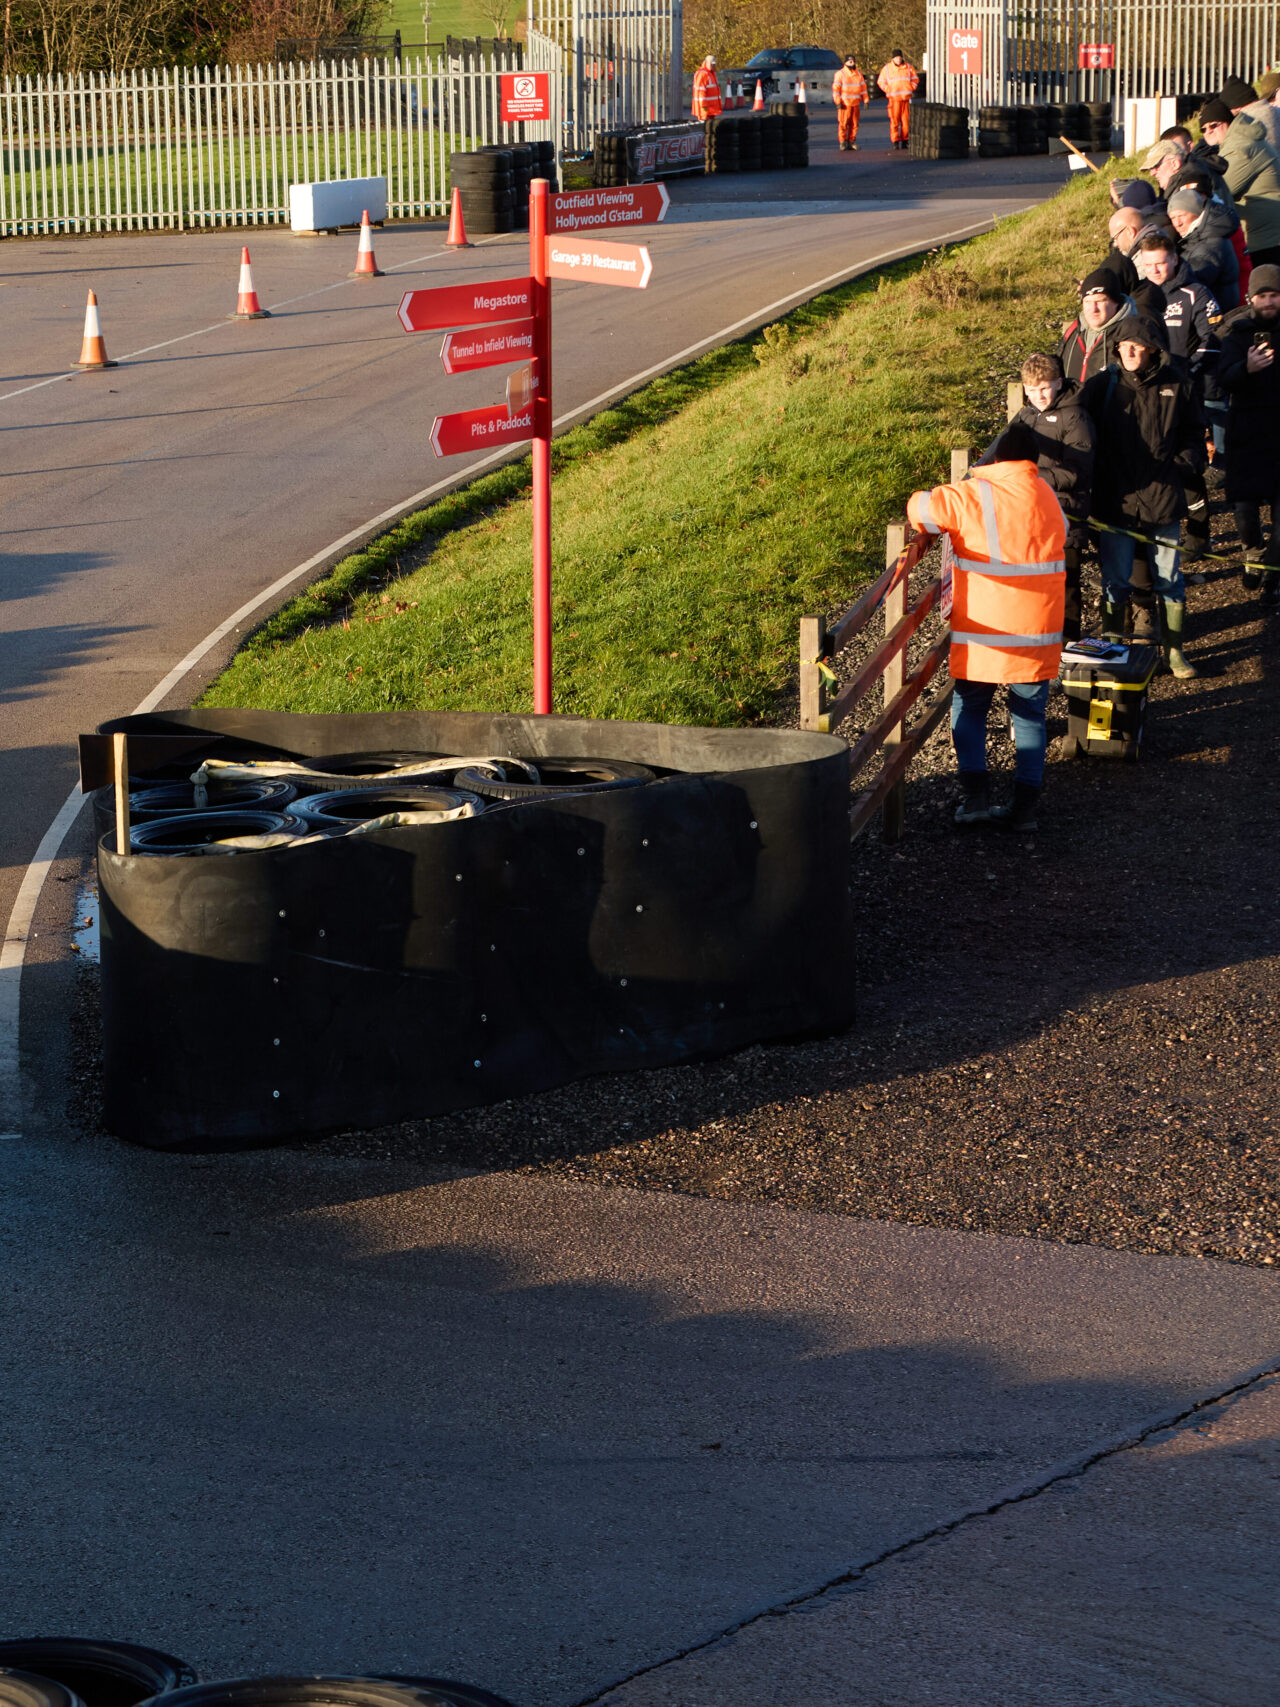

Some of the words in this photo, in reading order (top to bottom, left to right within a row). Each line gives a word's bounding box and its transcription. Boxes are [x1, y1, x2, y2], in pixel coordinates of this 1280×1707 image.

[952, 32, 978, 48] Gate
[960, 51, 968, 71] 1
[555, 193, 594, 210] Outfield
[597, 191, 634, 206] Viewing
[555, 210, 607, 229] Hollywood
[609, 206, 643, 222] G'stand
[552, 249, 580, 268] Garage
[581, 253, 592, 266] 39
[593, 254, 636, 272] Restaurant
[474, 294, 527, 311] Megastore
[452, 342, 475, 358] Tunnel
[476, 343, 483, 354] to
[484, 337, 505, 352] Infield
[506, 333, 532, 348] Viewing
[471, 422, 487, 436] Pits
[488, 420, 495, 433] &
[496, 413, 531, 431] Paddock
